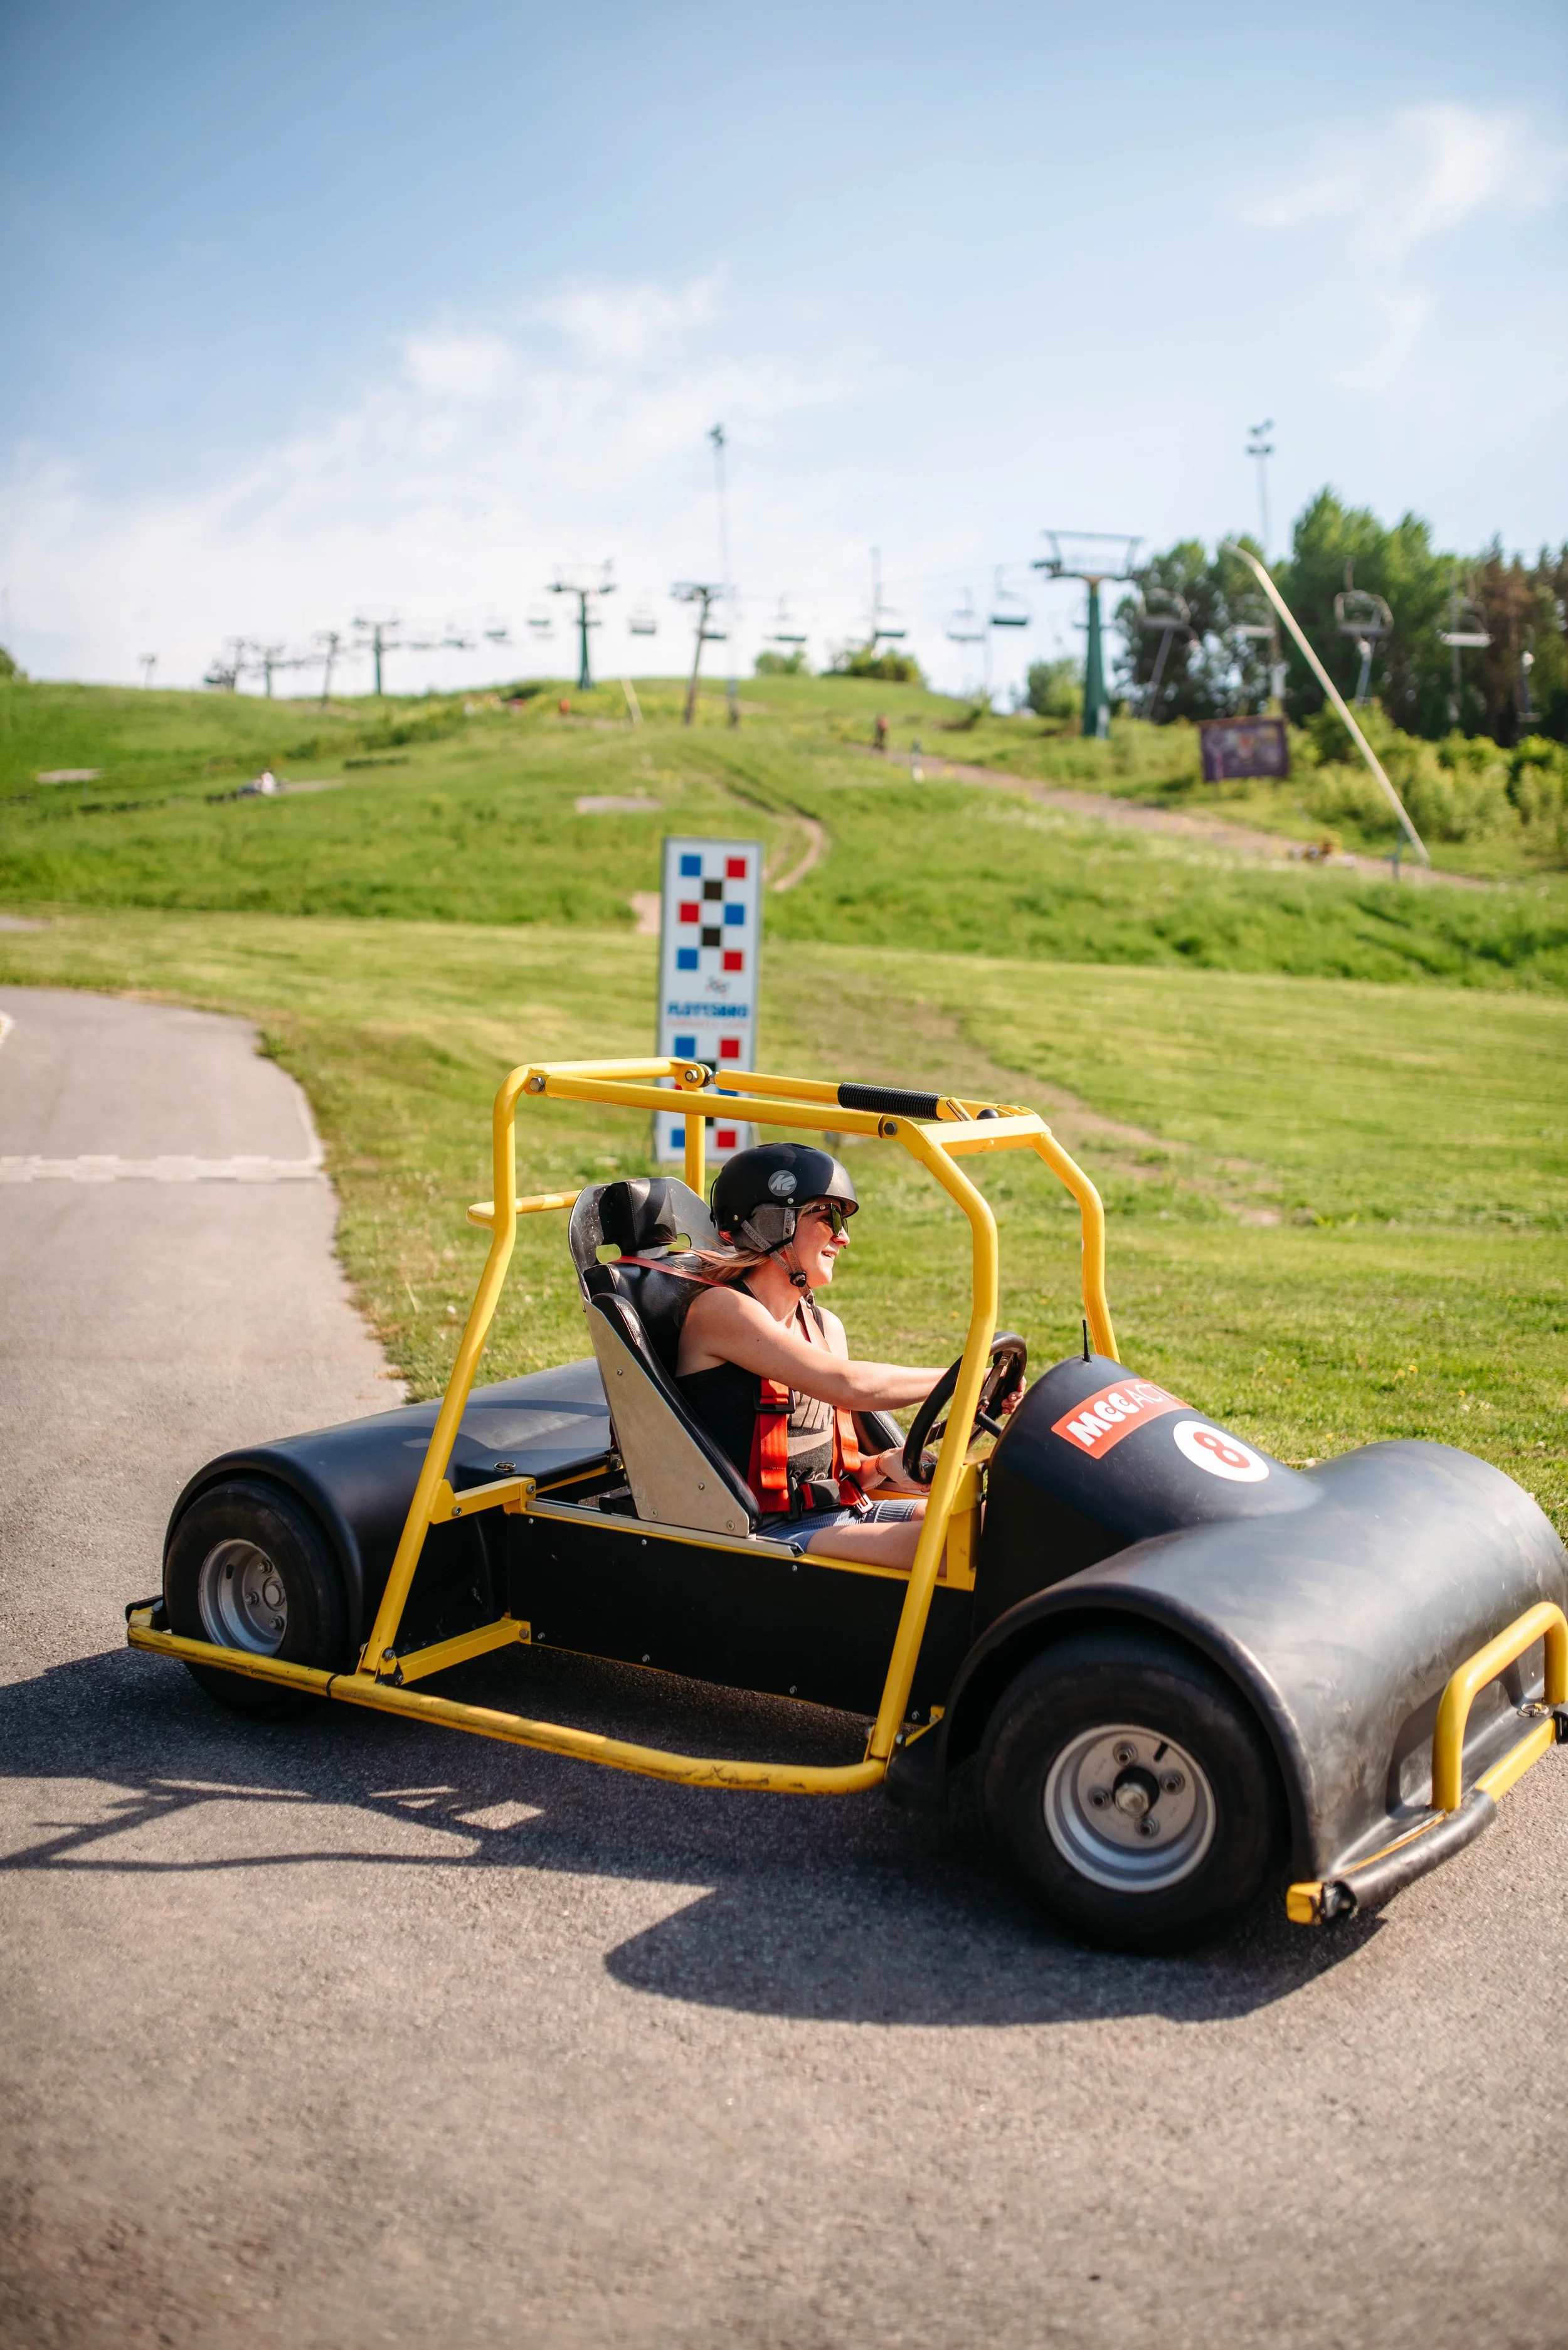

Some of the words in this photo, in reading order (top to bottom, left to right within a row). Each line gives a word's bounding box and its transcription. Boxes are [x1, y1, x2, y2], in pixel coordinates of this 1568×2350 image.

[770, 1175, 795, 1191] K2
[761, 1242, 769, 1250] PN
[1193, 1432, 1251, 1469] 8
